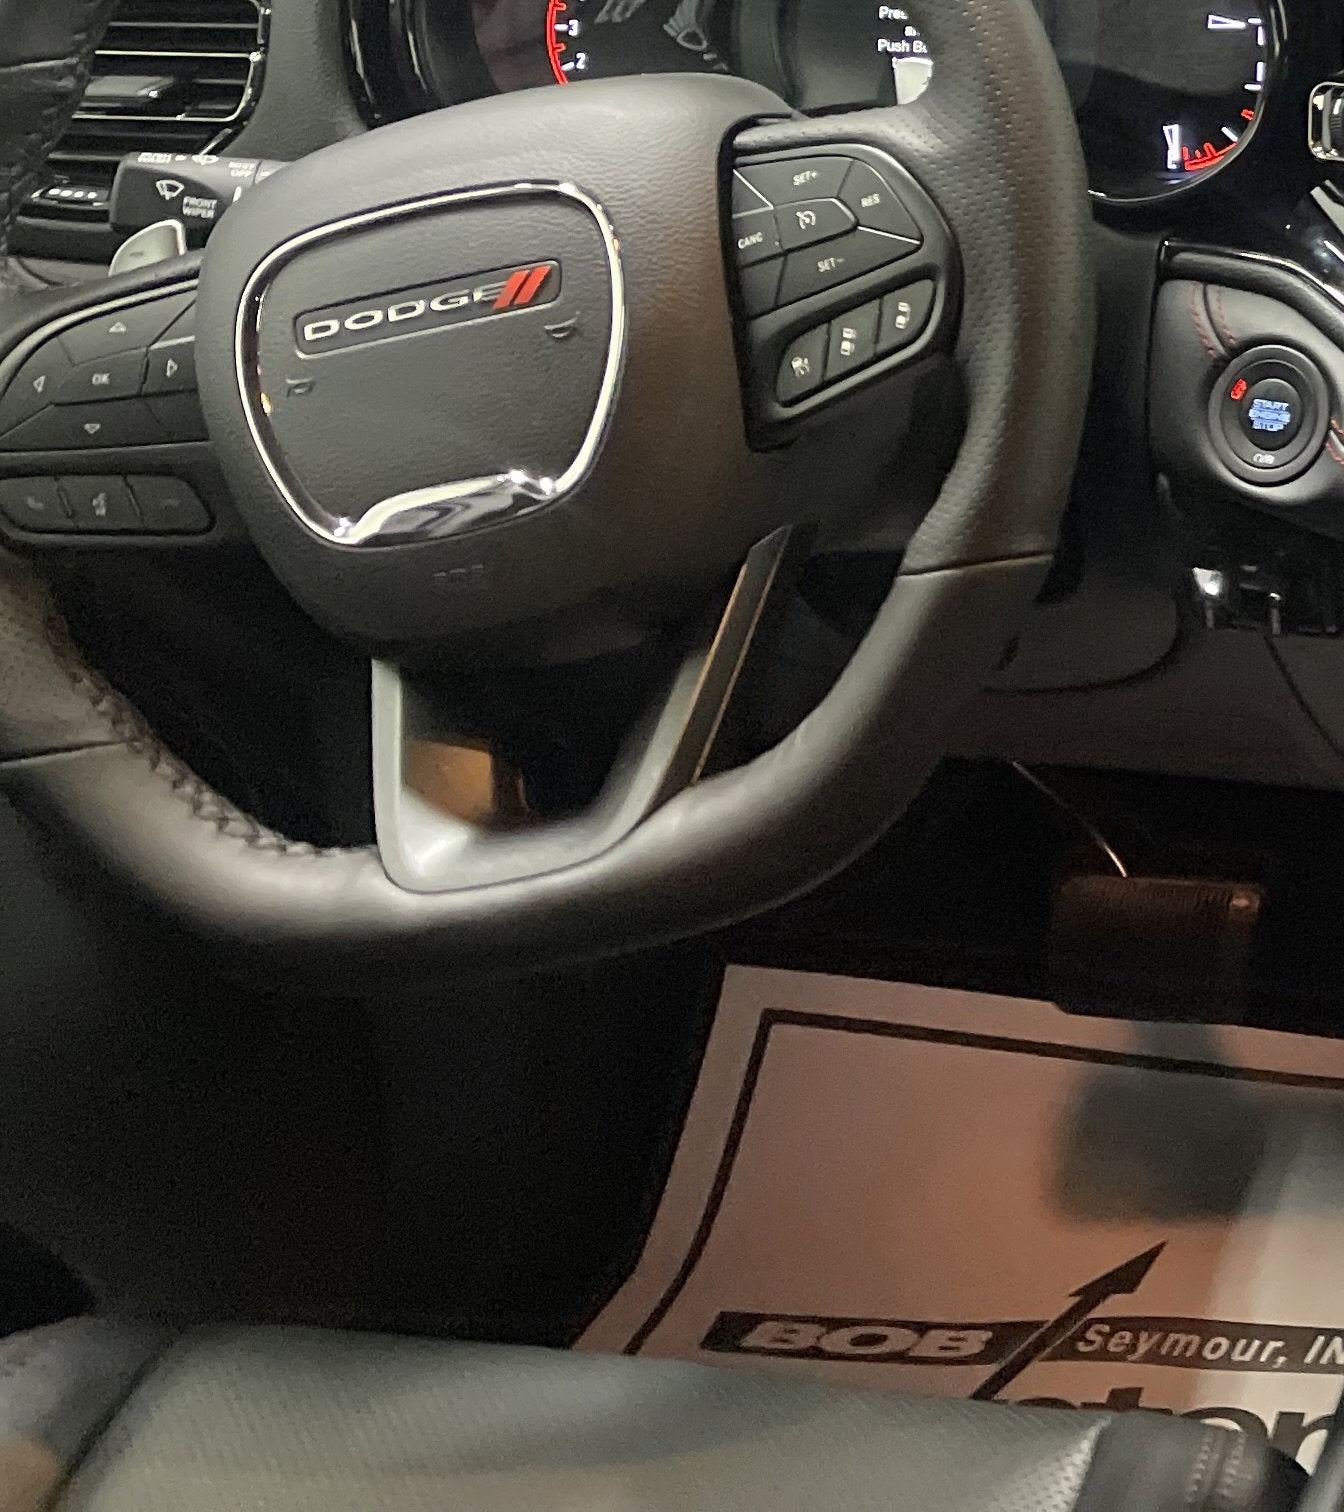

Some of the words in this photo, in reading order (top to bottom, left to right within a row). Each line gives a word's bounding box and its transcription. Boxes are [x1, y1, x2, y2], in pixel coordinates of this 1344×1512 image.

[567, 18, 579, 37] 3
[877, 38, 910, 53] Push
[575, 52, 587, 70] 2
[860, 193, 881, 208] RES
[737, 231, 764, 249] CANC
[303, 280, 508, 341] DODGE
[91, 372, 111, 386] OK
[1252, 398, 1290, 411] START
[740, 1320, 994, 1358] BOB
[1076, 1324, 1288, 1369] Seymour,
